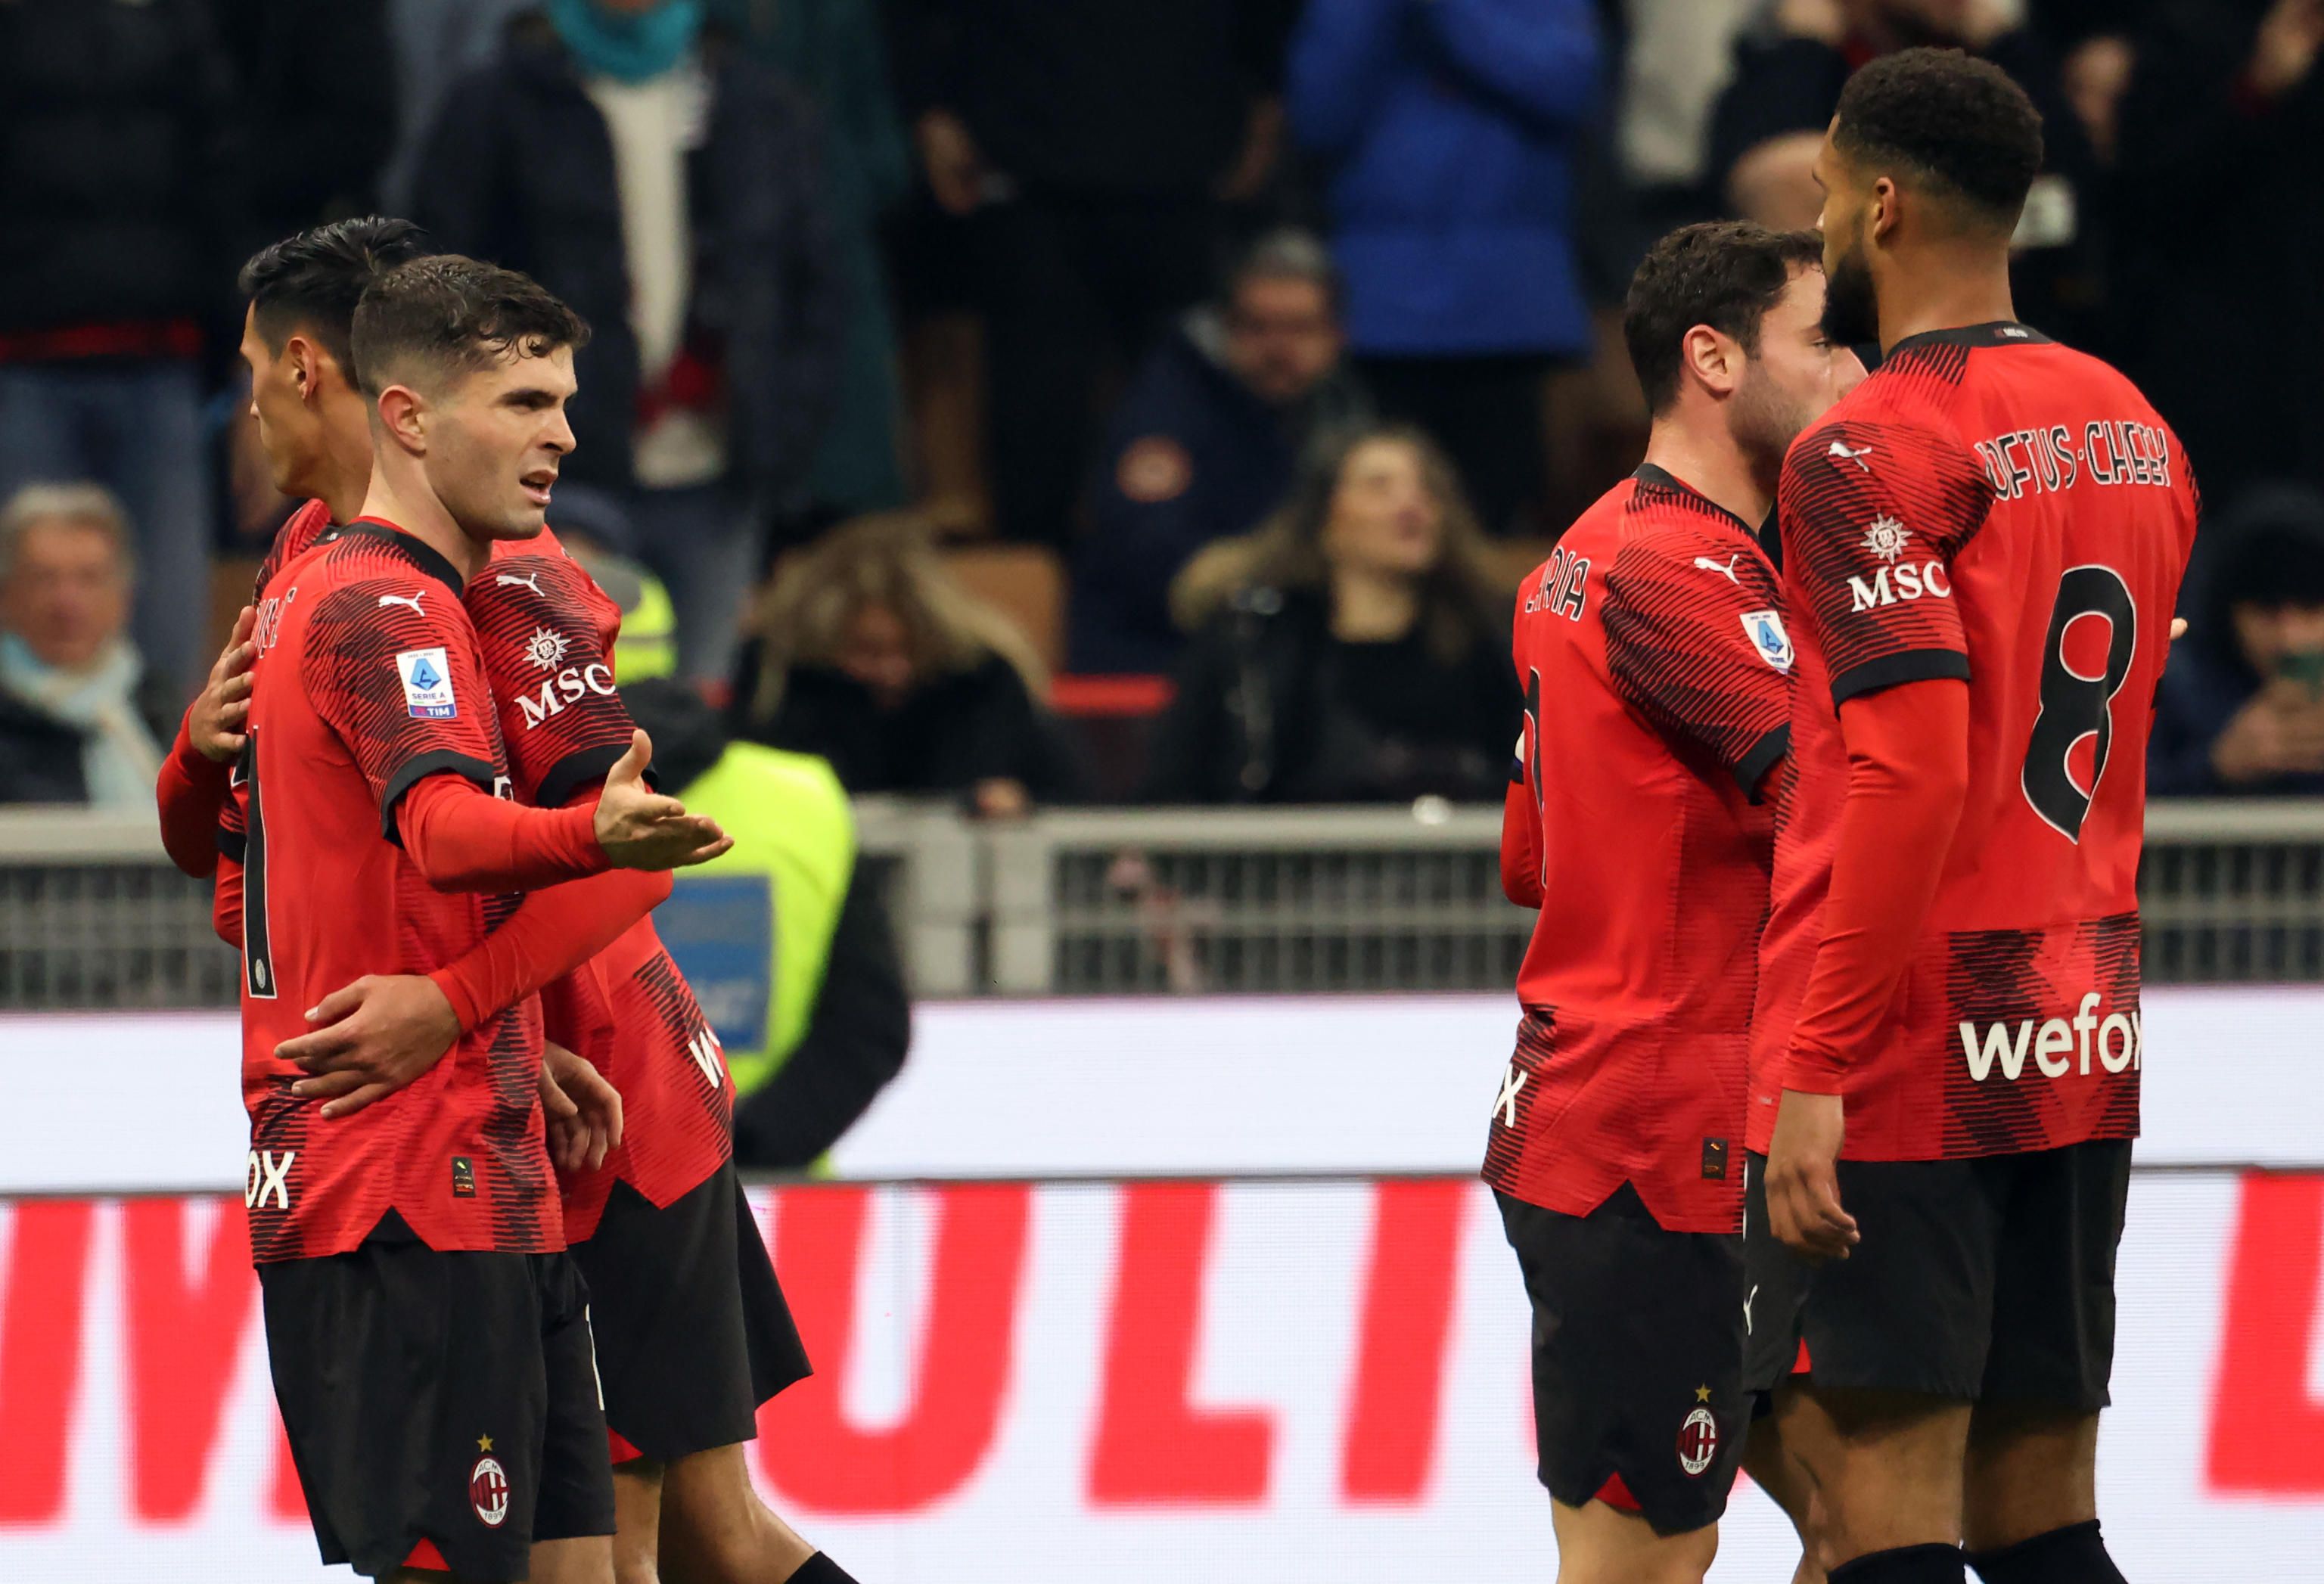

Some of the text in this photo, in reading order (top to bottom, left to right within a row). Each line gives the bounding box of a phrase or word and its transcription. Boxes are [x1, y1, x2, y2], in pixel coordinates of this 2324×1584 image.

[1847, 560, 1951, 613] MSC
[427, 707, 450, 716] TIM
[514, 663, 616, 730] MSC
[2021, 564, 2136, 845] 8
[1685, 1461, 1706, 1470] 1899
[484, 1511, 503, 1520] 1899
